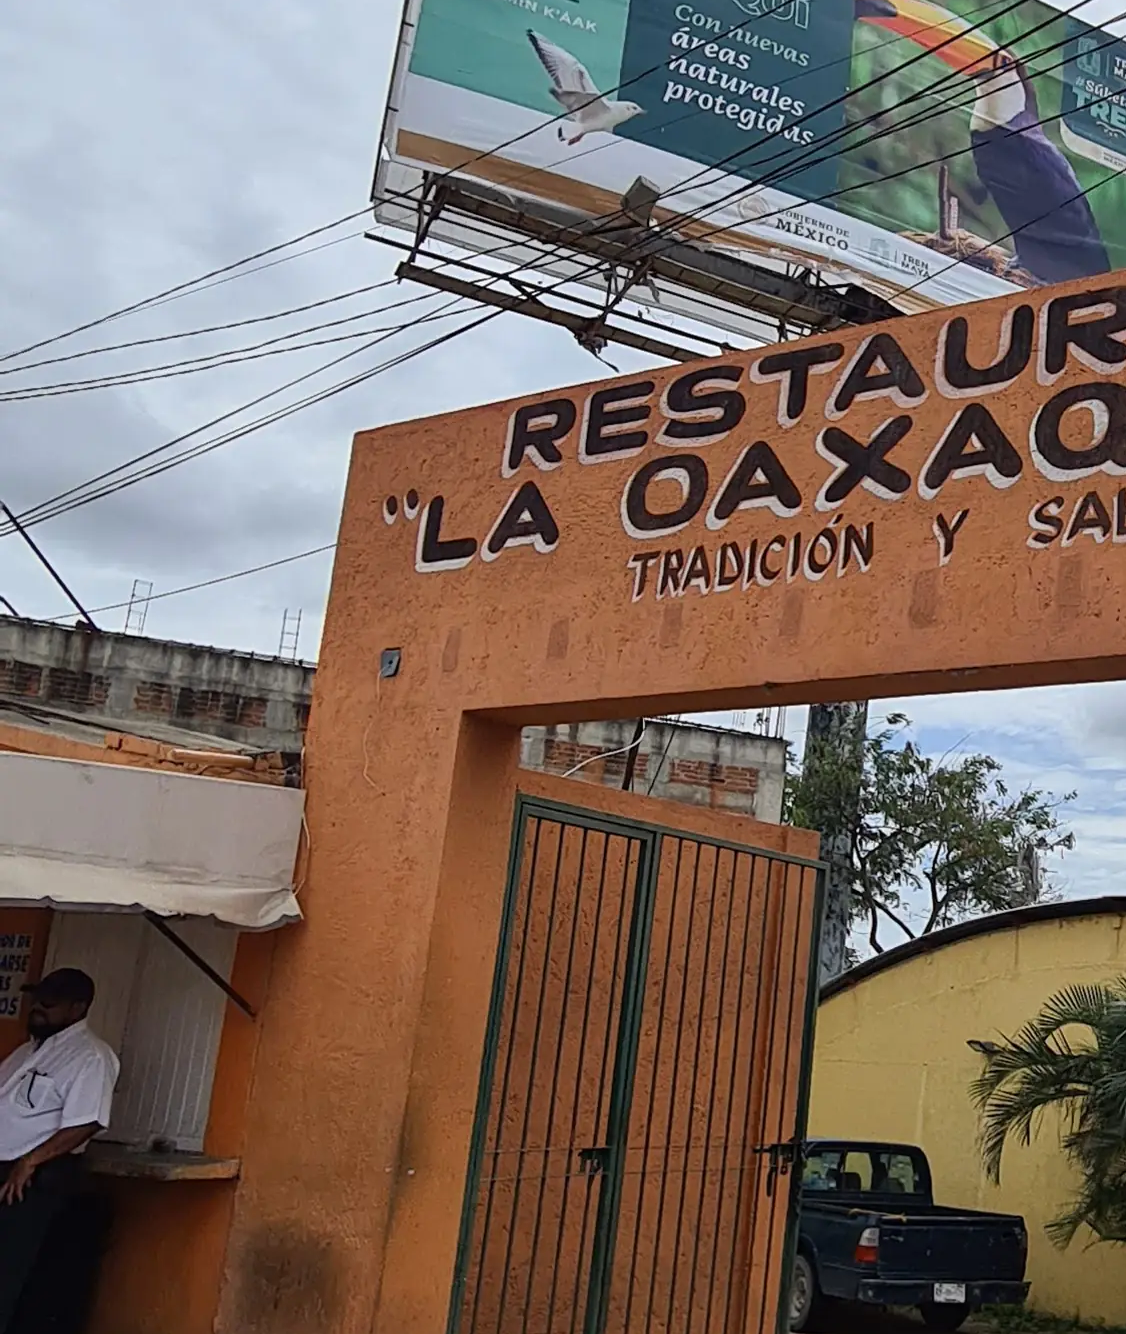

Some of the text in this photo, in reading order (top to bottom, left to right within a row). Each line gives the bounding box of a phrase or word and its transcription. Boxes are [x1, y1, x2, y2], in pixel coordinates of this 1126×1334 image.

[543, 5, 598, 33] K'AAK
[674, 3, 810, 67] Con nuevas
[671, 27, 751, 71] áreas
[667, 54, 806, 118] naturales
[662, 79, 816, 146] protegidas
[775, 217, 849, 251] MÉXICO
[836, 227, 851, 238] DE
[901, 252, 930, 270] TREN
[630, 513, 876, 603] TRADICIÓN
[932, 507, 971, 567] Y
